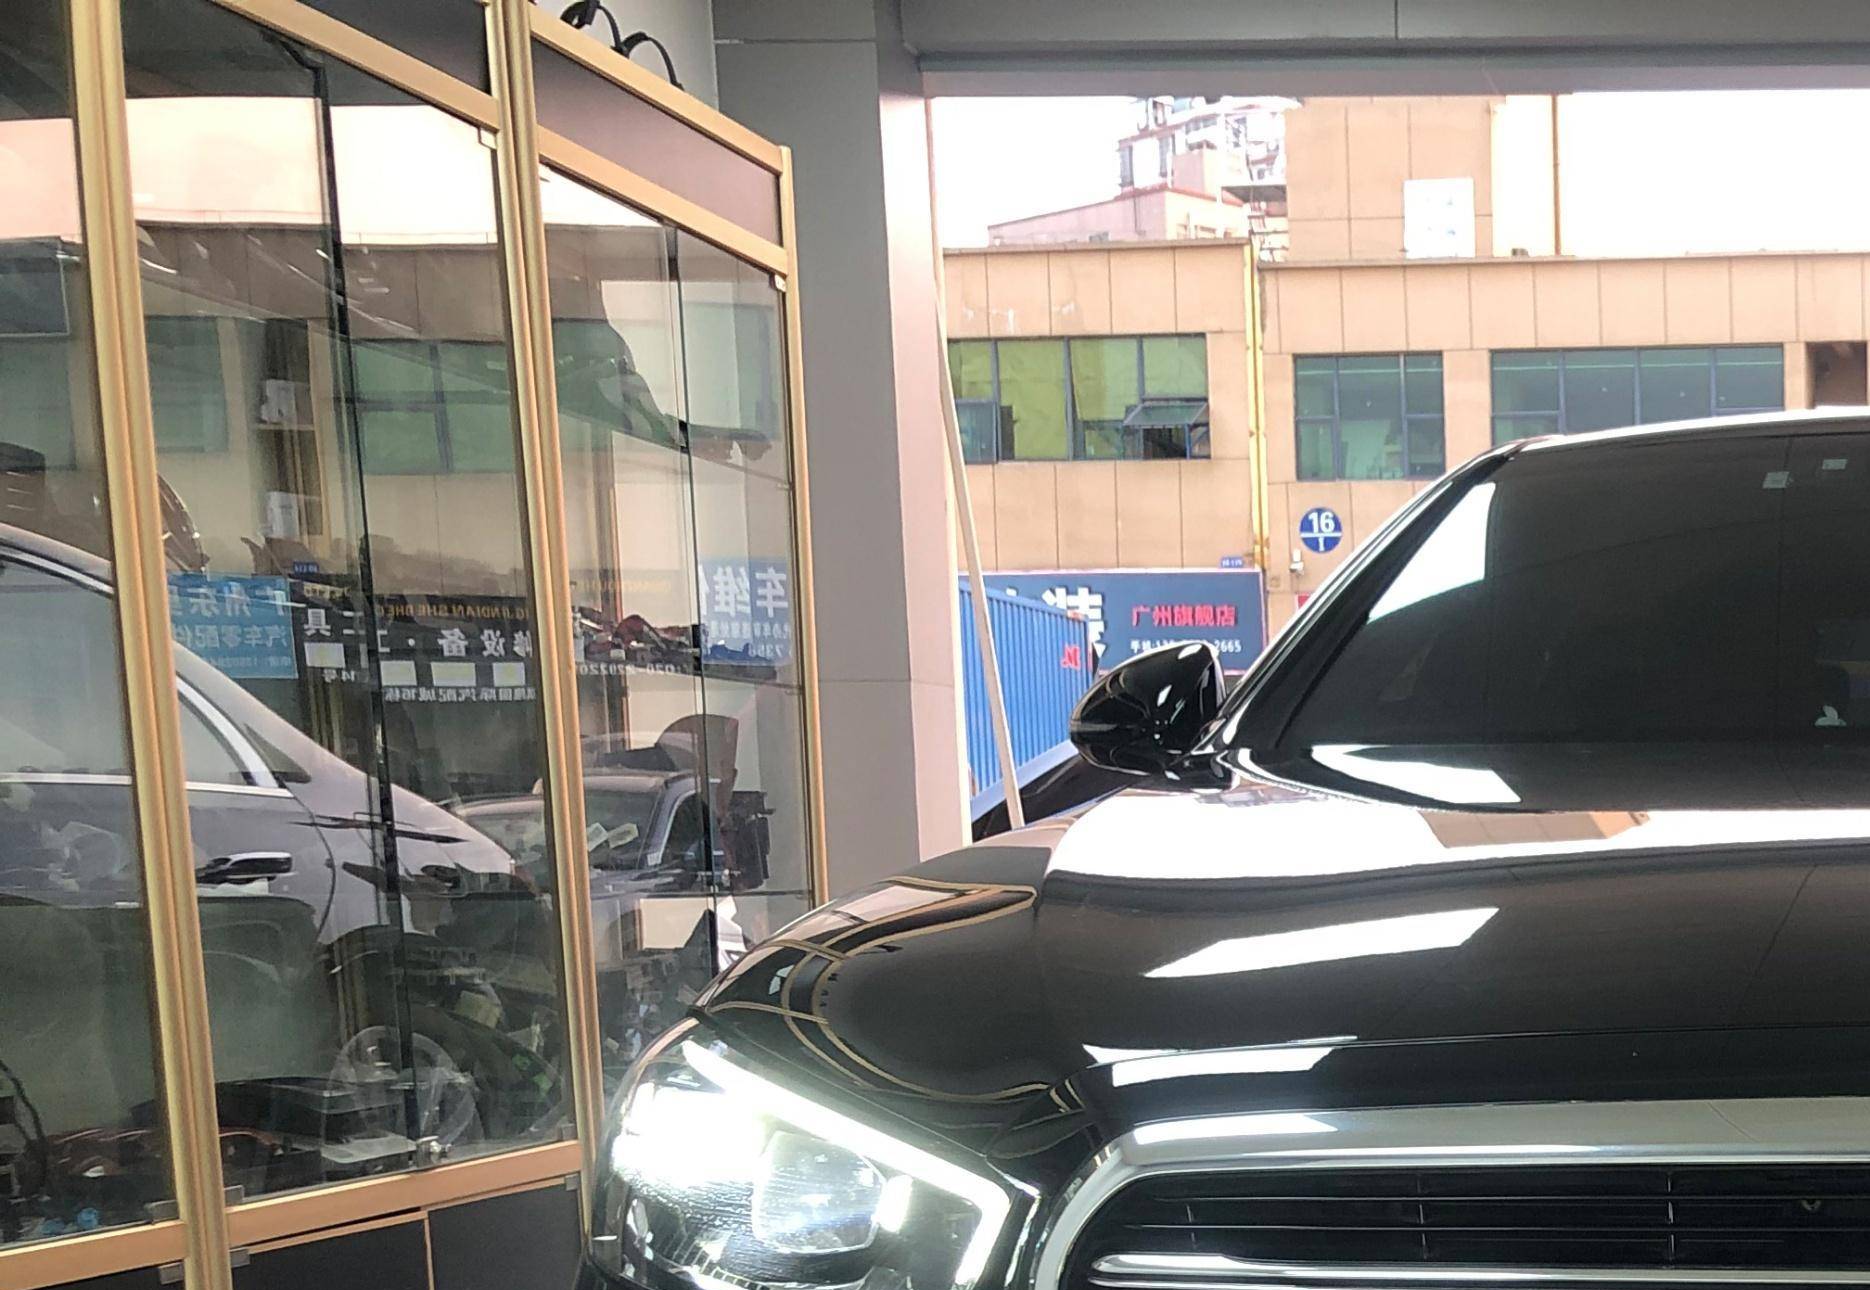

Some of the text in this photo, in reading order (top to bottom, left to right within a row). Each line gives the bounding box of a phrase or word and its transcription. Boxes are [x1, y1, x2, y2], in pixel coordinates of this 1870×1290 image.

[1308, 511, 1336, 533] 16
[1131, 604, 1236, 627] 广州旗舰店
